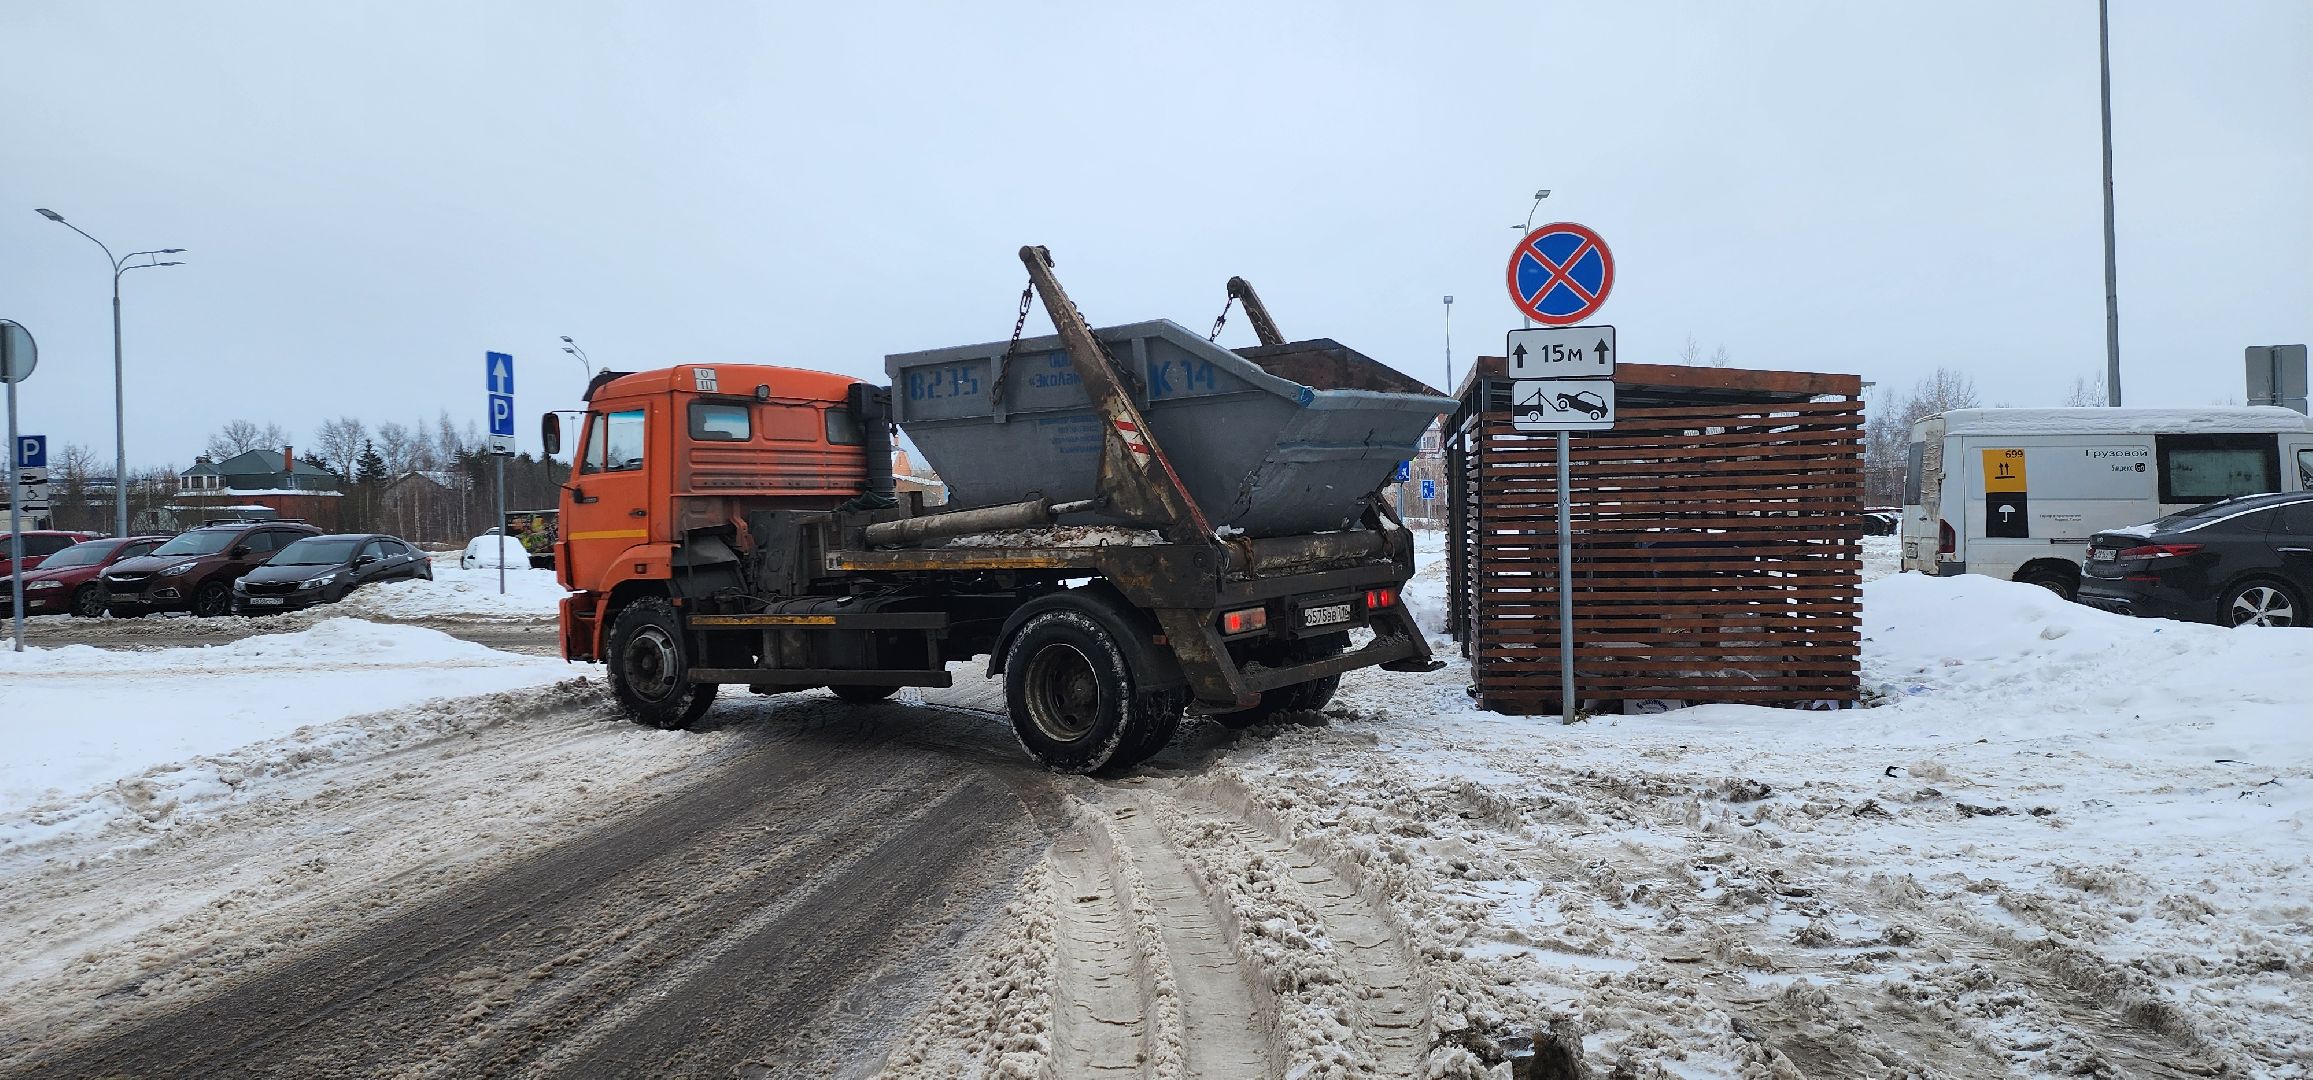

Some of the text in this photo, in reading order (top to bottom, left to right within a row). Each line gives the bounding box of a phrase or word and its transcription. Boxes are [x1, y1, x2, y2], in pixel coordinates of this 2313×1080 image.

[493, 398, 509, 431] P
[22, 439, 40, 465] P
[2005, 449, 2024, 459] 699
[2085, 448, 2148, 459] Грузовой
